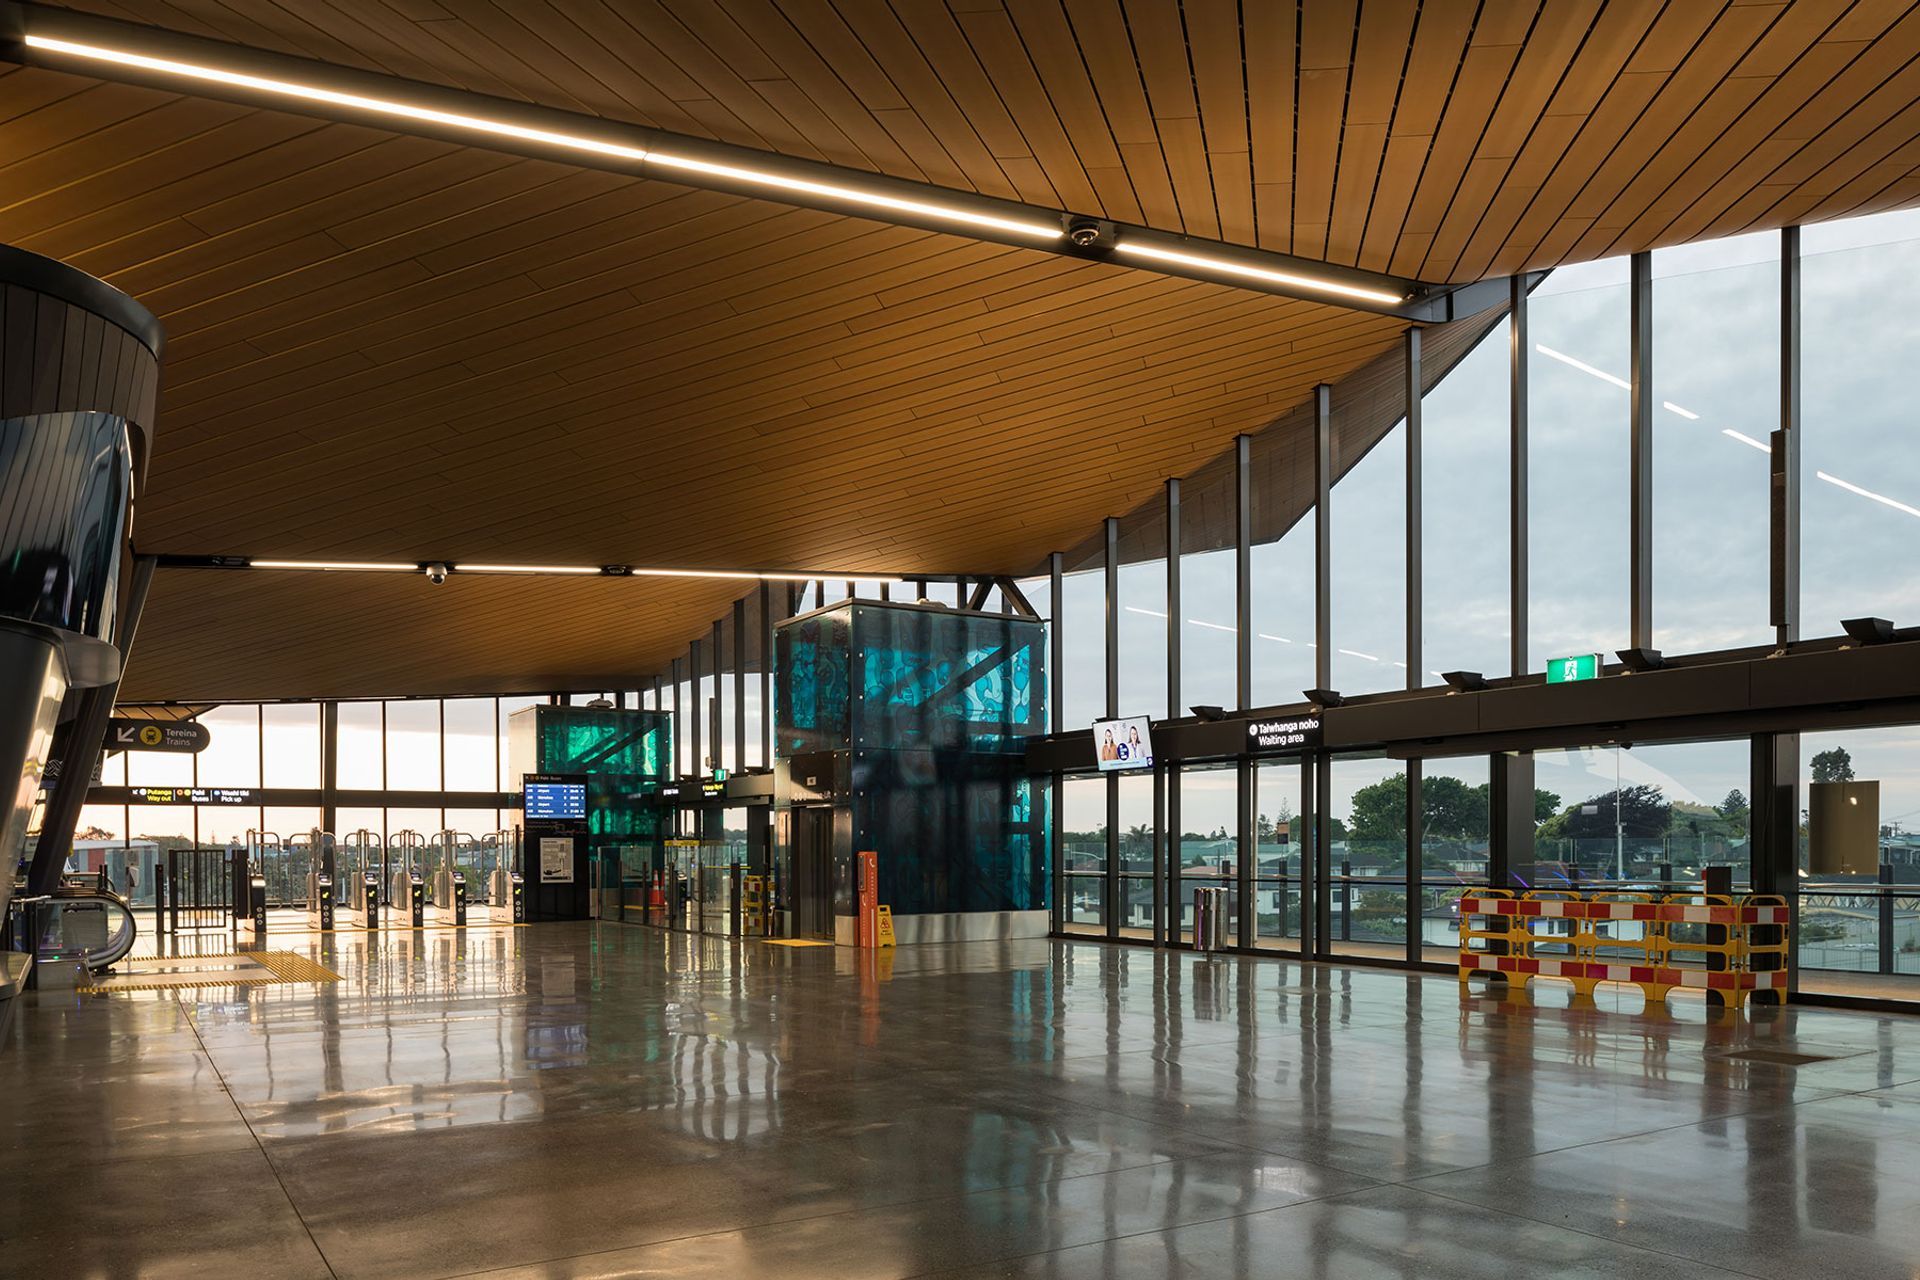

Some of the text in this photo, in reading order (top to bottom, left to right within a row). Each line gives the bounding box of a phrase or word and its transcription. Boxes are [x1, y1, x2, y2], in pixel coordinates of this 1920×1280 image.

[166, 728, 197, 737] Tereina
[1258, 719, 1319, 734] Taiwhanga noho
[1258, 734, 1304, 746] Waiting area
